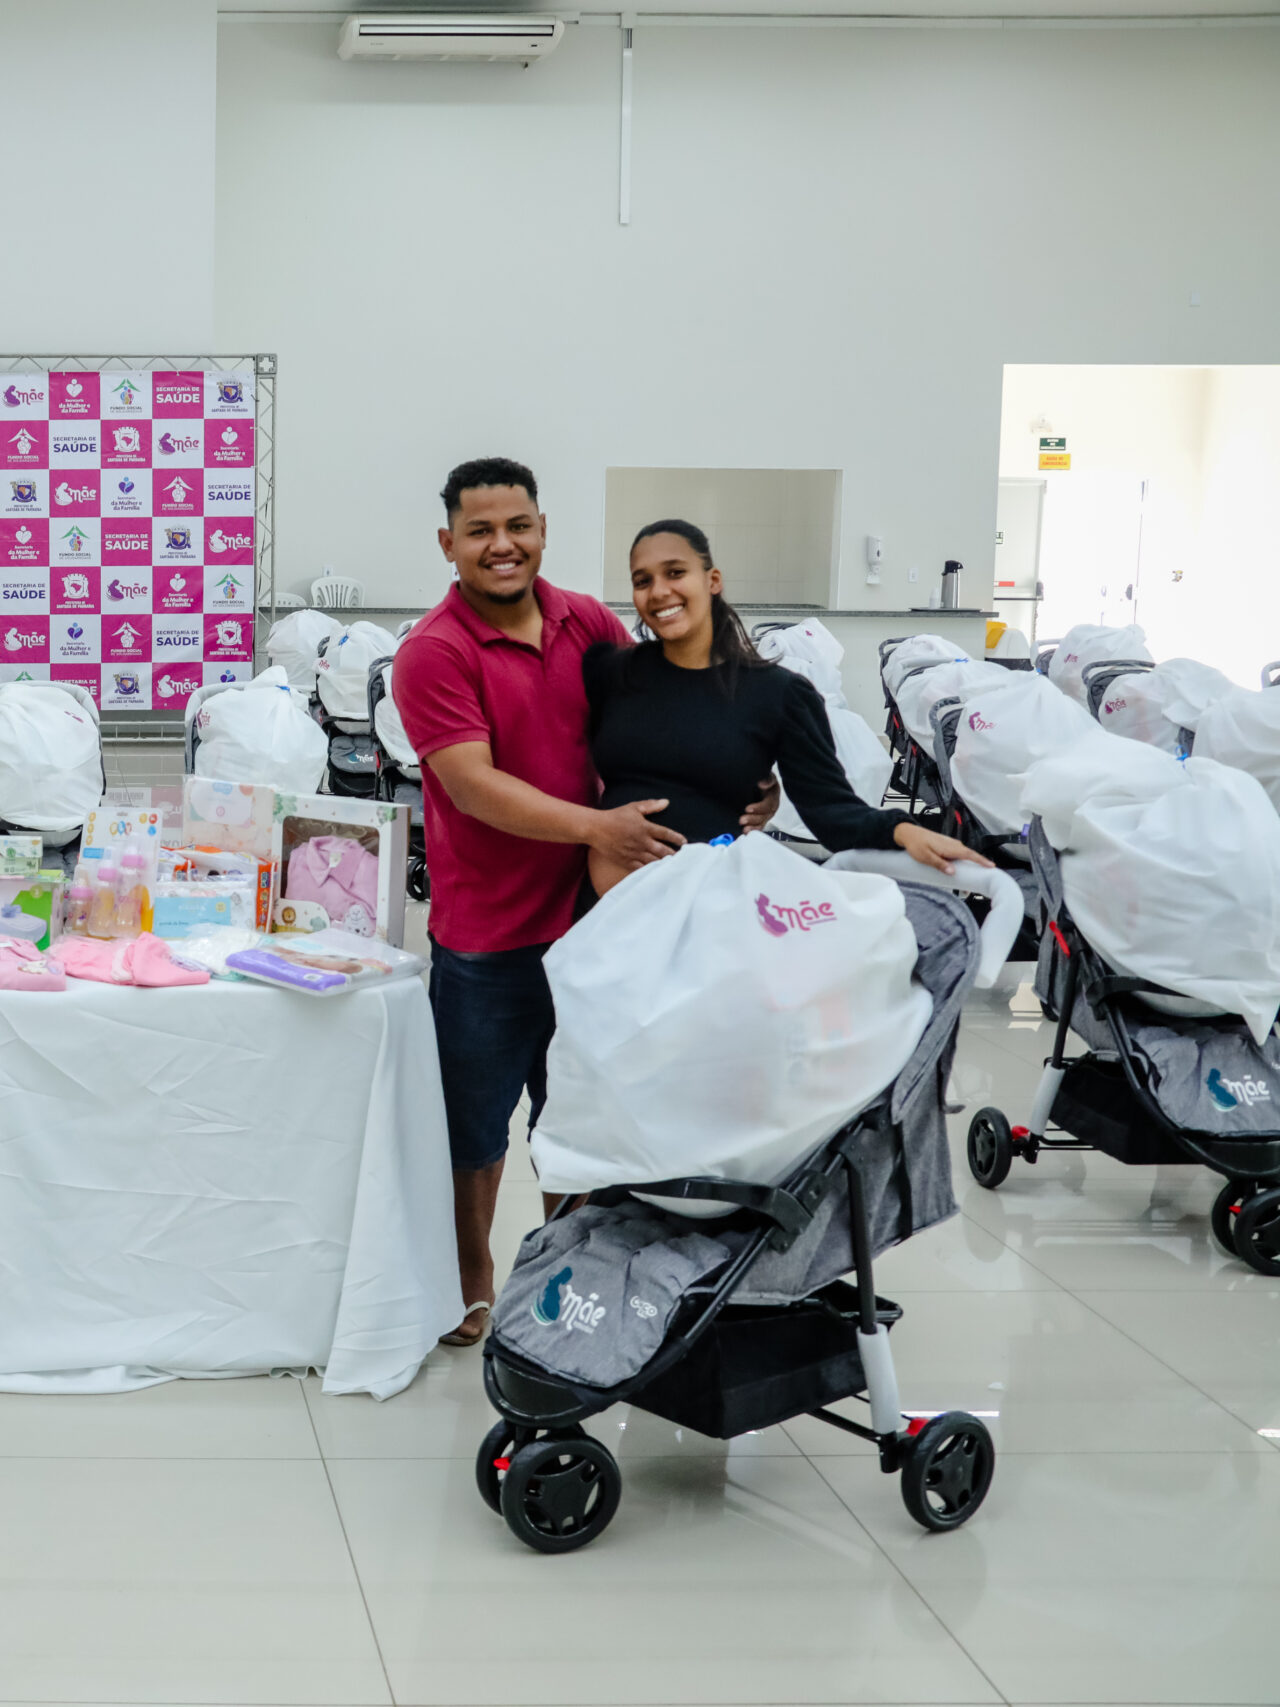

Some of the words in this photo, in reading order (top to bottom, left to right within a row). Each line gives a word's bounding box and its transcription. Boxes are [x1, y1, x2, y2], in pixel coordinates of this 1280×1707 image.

[16, 389, 44, 405] mãe
[156, 392, 199, 403] SAÚDE
[54, 441, 97, 453] SAÚDE
[172, 437, 199, 452] mãe
[68, 486, 96, 502] mãe
[208, 489, 252, 500] SAÚDE
[105, 539, 148, 550] SAÚDE
[223, 534, 251, 550] mãe
[3, 587, 46, 599] SAÚDE
[120, 583, 147, 599] mãe
[19, 632, 45, 648] mãe
[157, 634, 200, 646] SAÚDE
[771, 900, 835, 932] mãe
[1222, 1074, 1270, 1106] mãe
[561, 1284, 606, 1331] mãe
